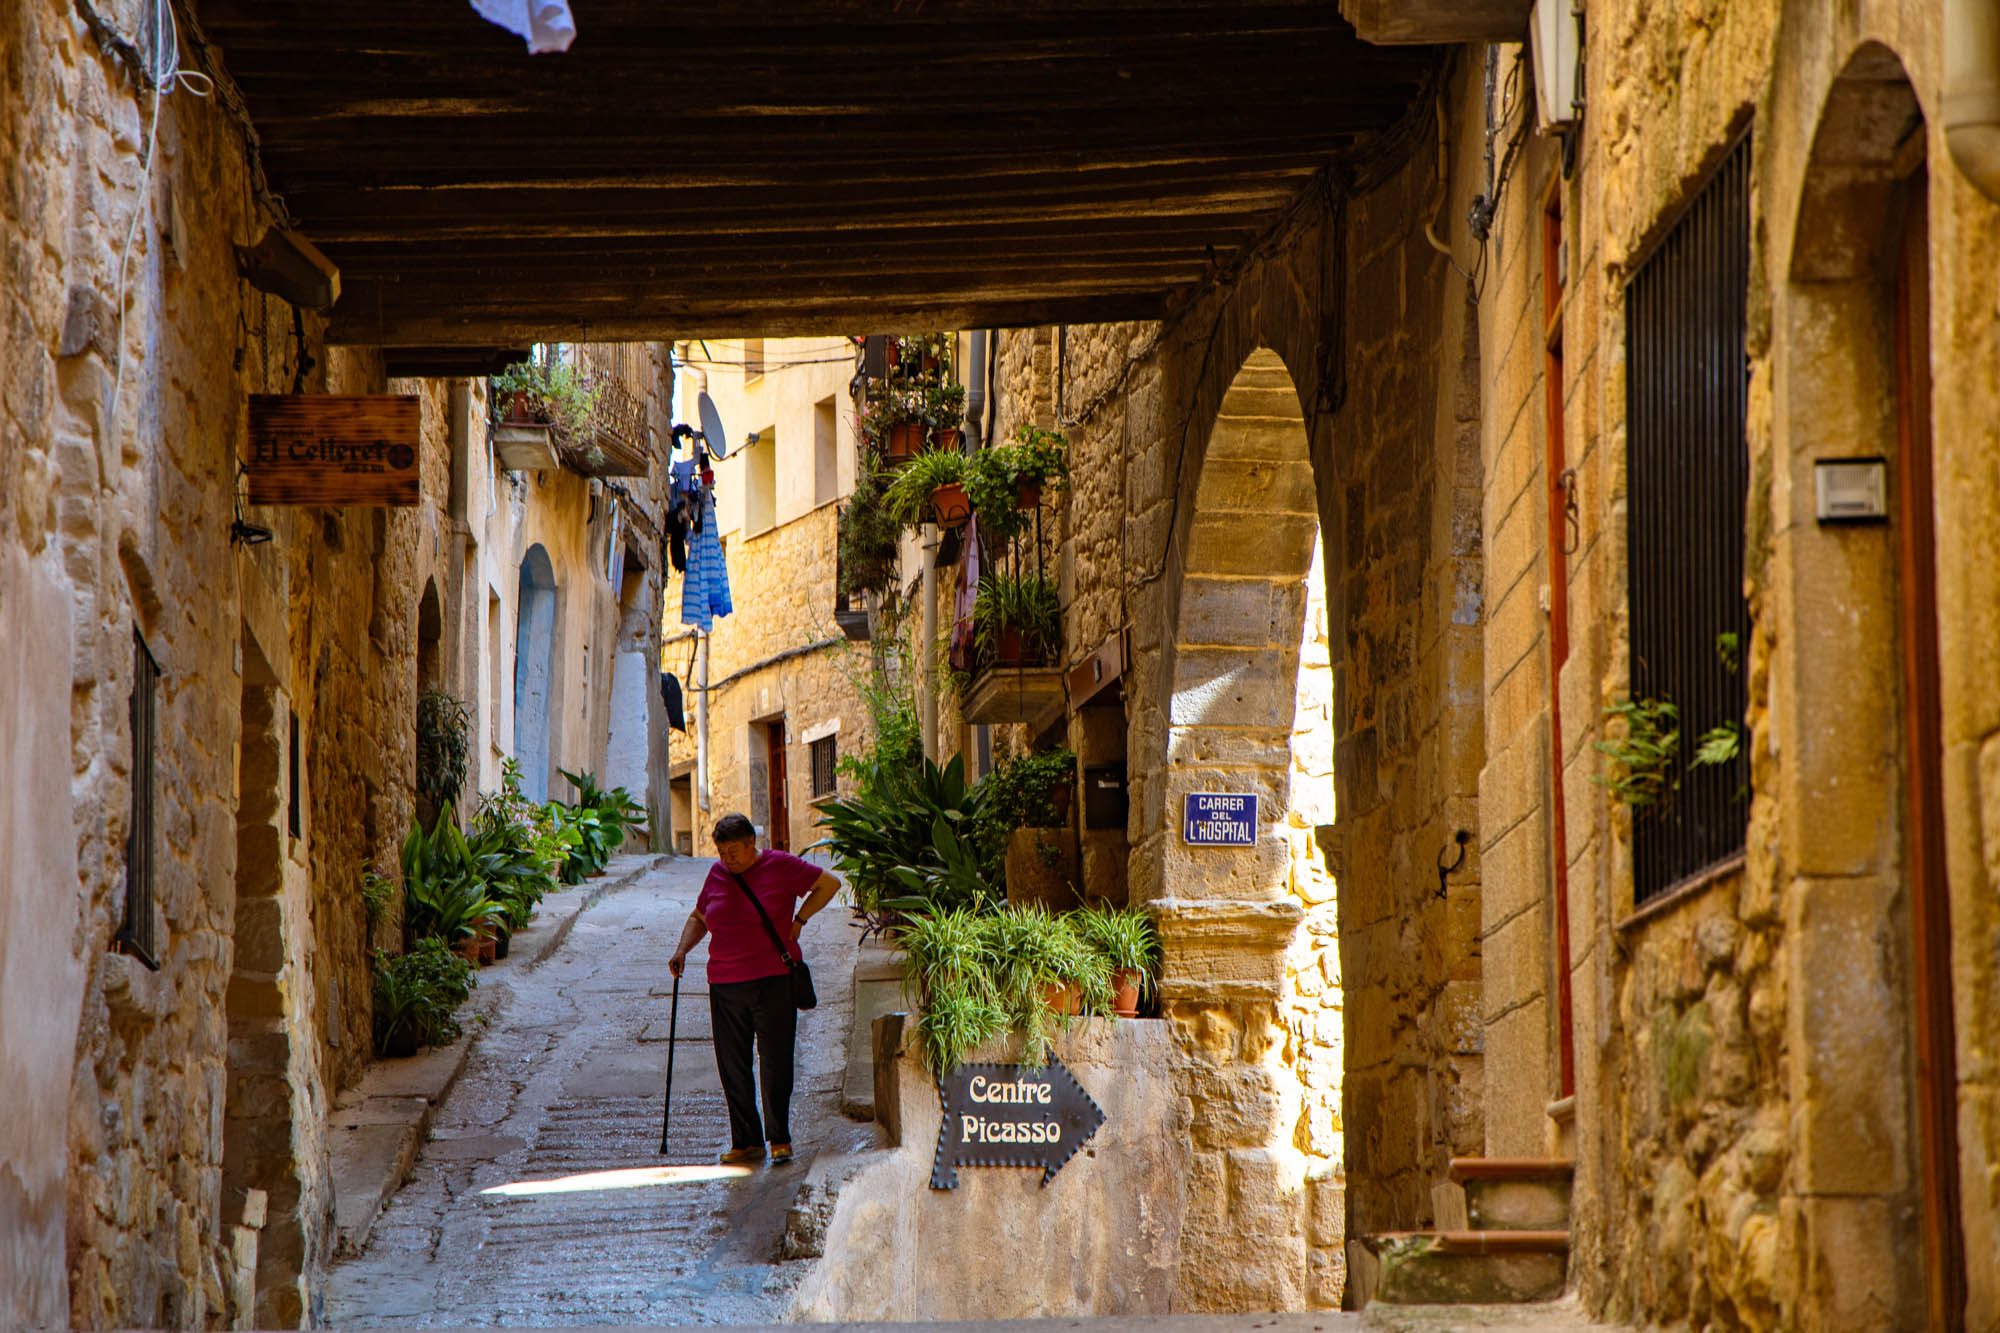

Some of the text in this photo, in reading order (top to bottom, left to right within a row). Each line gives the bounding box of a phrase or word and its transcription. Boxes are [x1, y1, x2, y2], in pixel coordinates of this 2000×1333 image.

[255, 438, 279, 463] El
[1199, 797, 1244, 811] CARRER
[1211, 811, 1231, 820] DEL
[1190, 820, 1251, 841] L'HOSPITAL
[969, 1075, 1051, 1104] Centre
[961, 1115, 1061, 1143] Picasso
